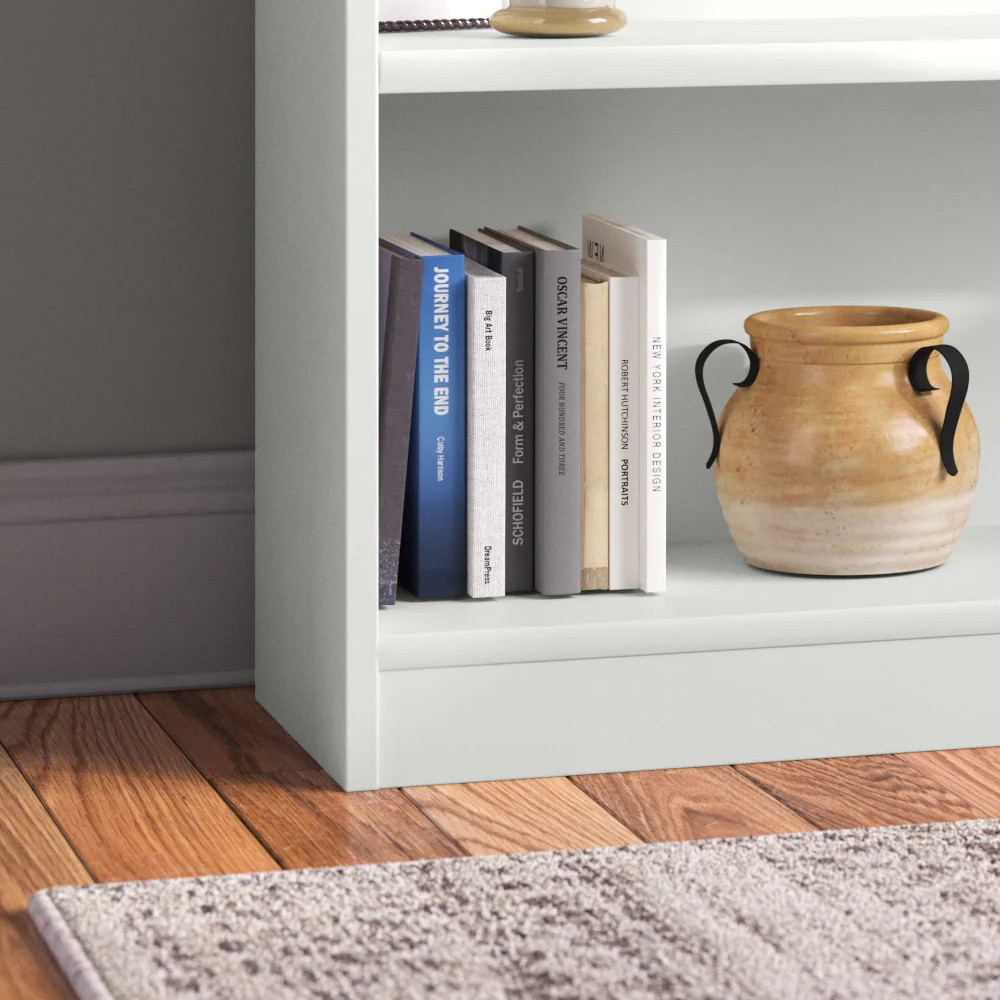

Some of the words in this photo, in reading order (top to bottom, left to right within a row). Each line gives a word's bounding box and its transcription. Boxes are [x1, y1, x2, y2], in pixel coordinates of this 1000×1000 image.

[433, 266, 450, 332] JOURNEY
[557, 276, 568, 315] OSCAR
[484, 310, 493, 321] Big
[485, 323, 493, 333] Art
[433, 335, 450, 352] TO
[485, 336, 493, 351] Book
[557, 317, 568, 370] VINCENT
[652, 336, 662, 359] NEW
[433, 356, 450, 384] THE
[652, 364, 662, 392] YORK
[433, 387, 450, 416] END
[513, 360, 524, 418] Perfection
[513, 421, 524, 431] &
[652, 397, 662, 448] INTERIOR
[436, 436, 445, 454] Colby
[513, 434, 524, 464] Form
[436, 455, 445, 482] Harrison
[652, 453, 662, 492] DESIGN
[512, 480, 524, 545] SCHOFIELD
[484, 546, 492, 584] DreamPress
